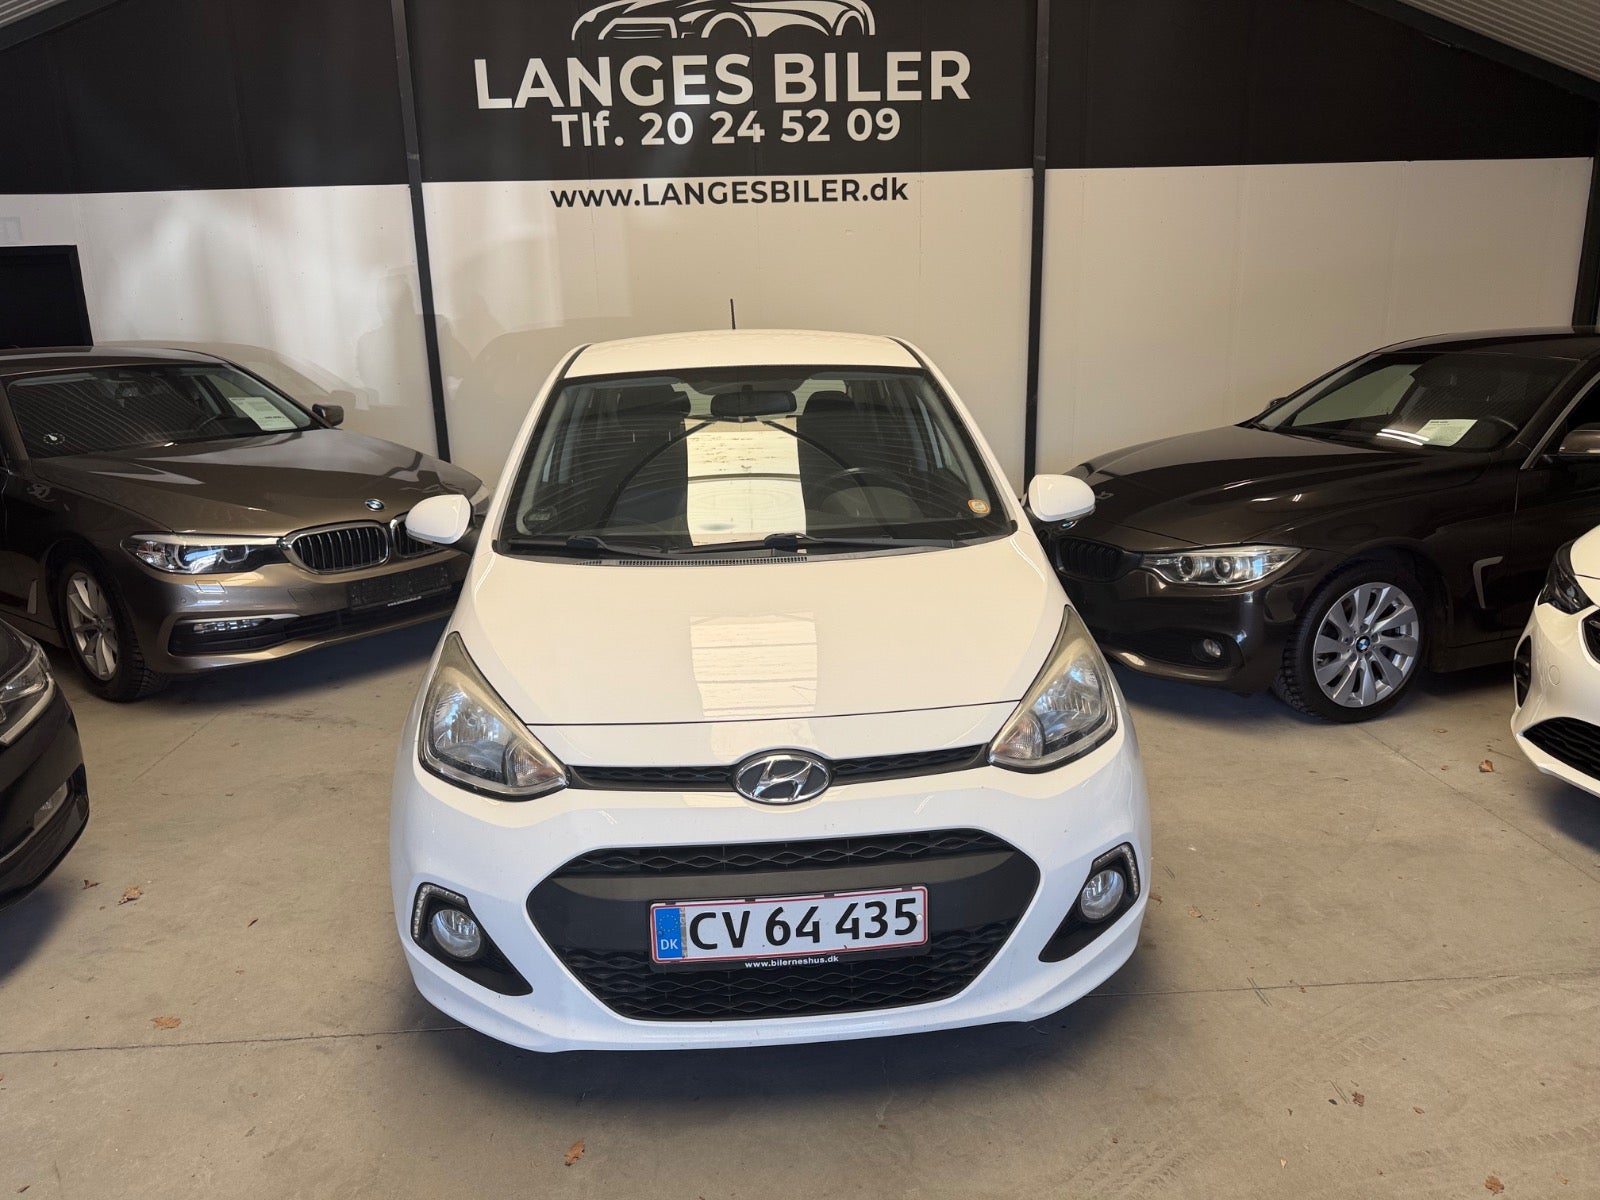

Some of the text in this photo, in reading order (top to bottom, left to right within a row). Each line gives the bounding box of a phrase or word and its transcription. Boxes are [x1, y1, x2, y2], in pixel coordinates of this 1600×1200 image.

[473, 50, 972, 110] LANGES BILER
[551, 107, 902, 147] Tlf. 20 24 52 09
[550, 176, 909, 208] www.LANGESBILER.dk
[689, 897, 918, 950] CV 64 435
[660, 938, 679, 950] DK
[744, 955, 840, 968] www.bilerneshus.dk
